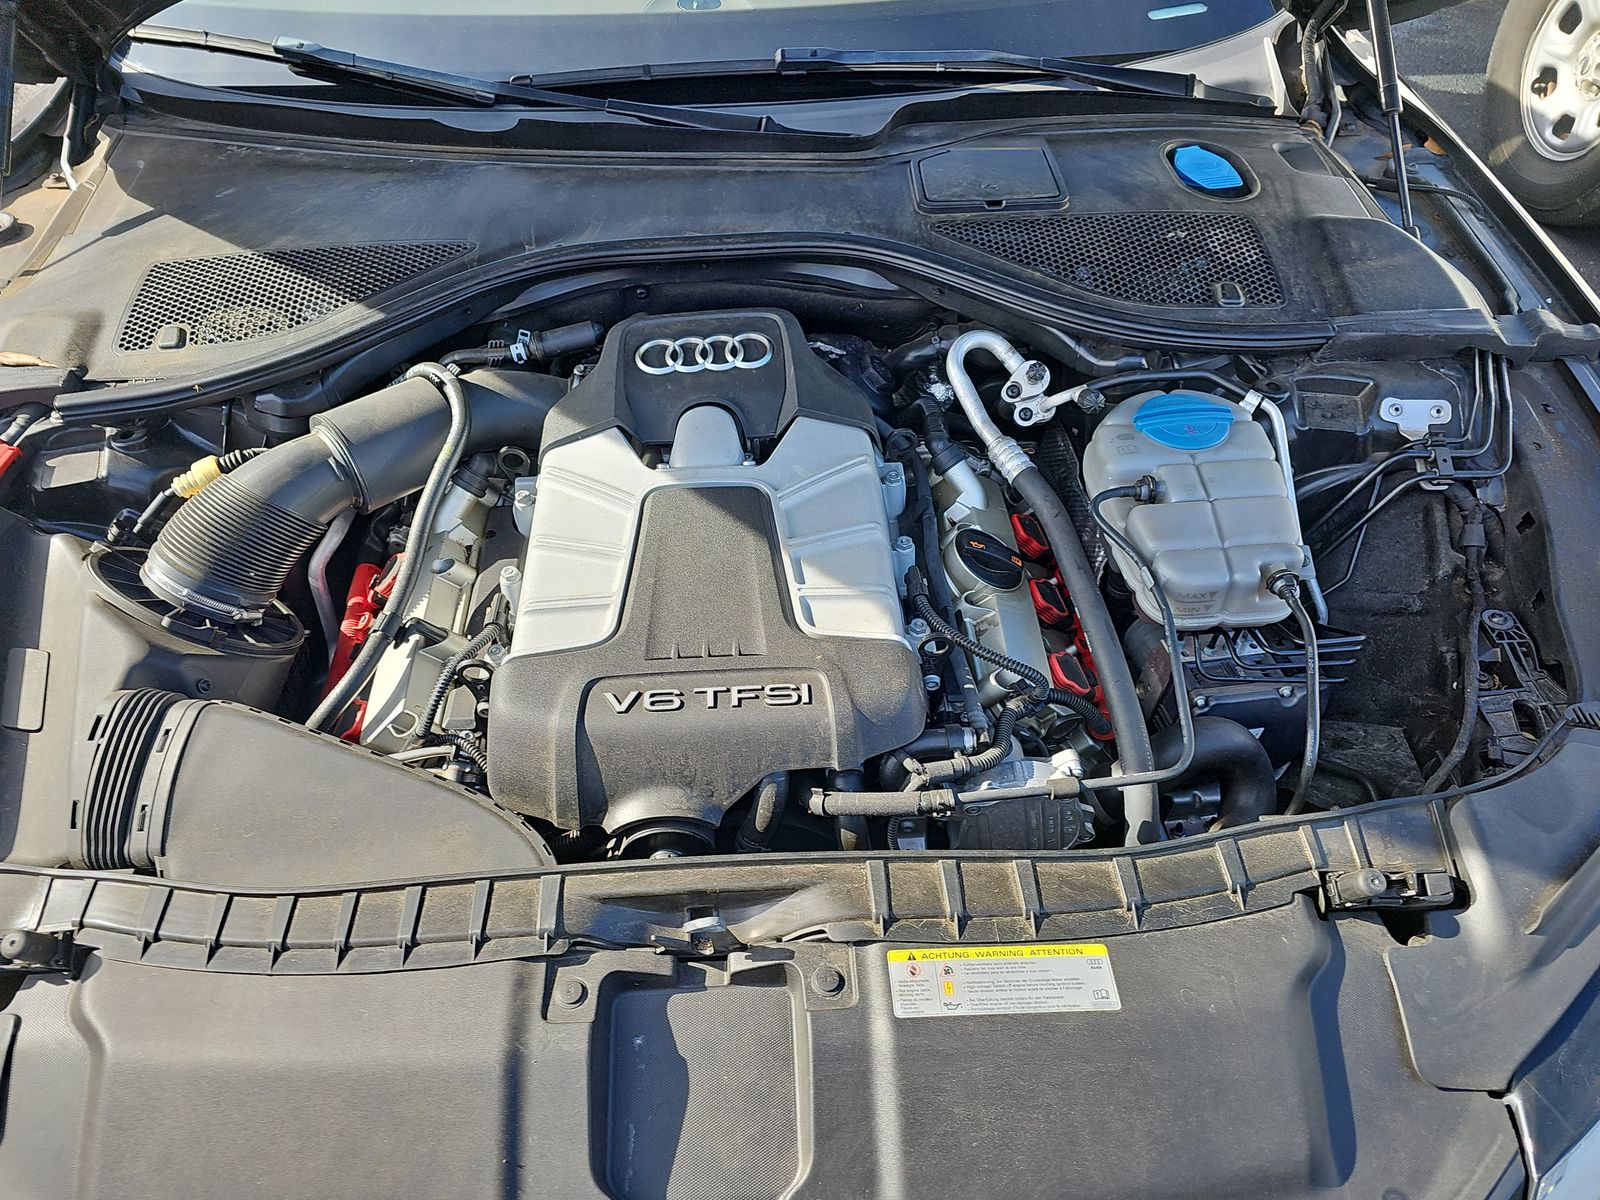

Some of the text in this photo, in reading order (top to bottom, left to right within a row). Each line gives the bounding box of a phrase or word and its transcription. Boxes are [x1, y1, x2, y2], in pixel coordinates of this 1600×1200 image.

[1179, 591, 1208, 600] MAX
[604, 682, 813, 714] V6 TFSI
[921, 947, 1084, 961] ACHTUNG WARNING ATTENTION
